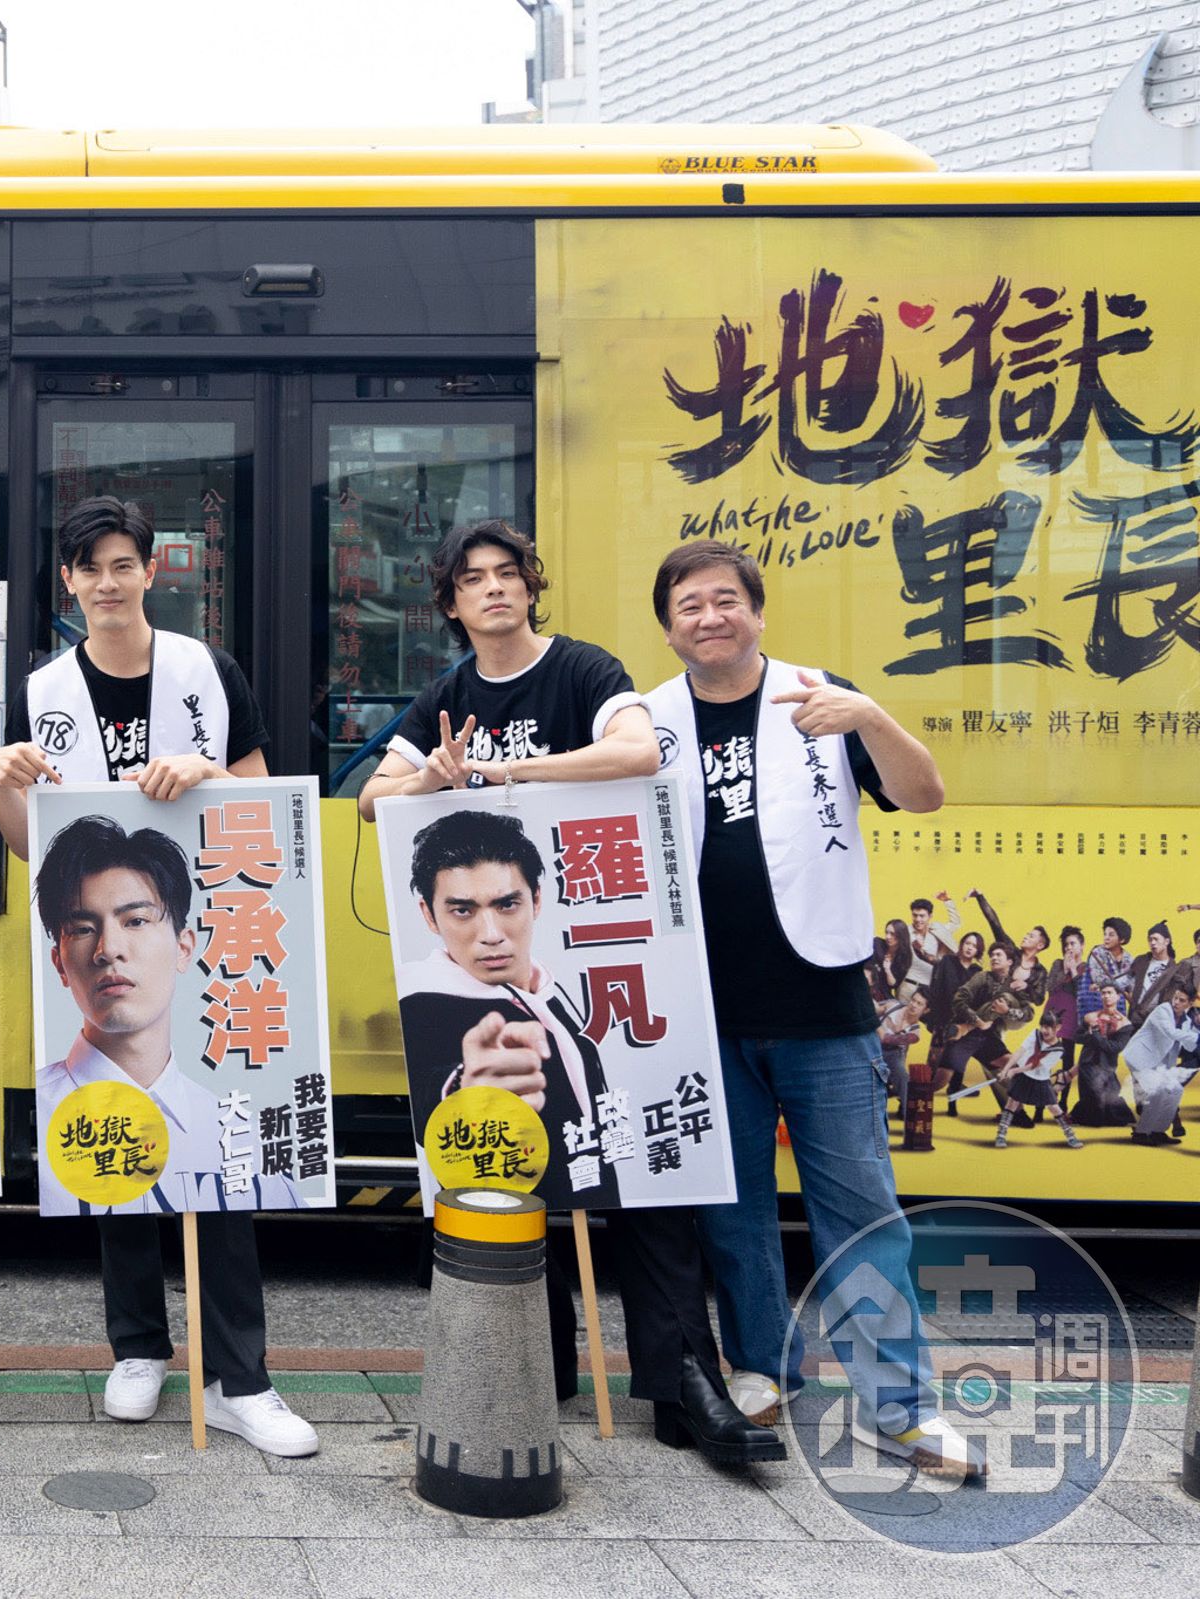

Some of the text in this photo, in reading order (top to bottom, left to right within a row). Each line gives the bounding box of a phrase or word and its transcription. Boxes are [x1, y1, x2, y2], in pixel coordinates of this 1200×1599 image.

[685, 156, 817, 168] BLUE STAR
[658, 268, 1200, 486] 地獄
[883, 480, 1200, 686] 里長
[38, 716, 74, 752] 78
[922, 717, 952, 732] 導演
[962, 710, 1032, 733] 瞿友寧
[196, 800, 290, 1068] 吳承洋
[554, 814, 668, 1047] 羅一凡
[60, 1115, 140, 1148] 地獄
[218, 1088, 253, 1196] 大仁哥
[259, 1103, 293, 1177] 新版
[293, 1072, 327, 1179] 我要當
[437, 1118, 517, 1151] 地獄
[642, 1099, 682, 1175] 正義
[675, 1071, 713, 1145] 公平
[94, 1145, 158, 1177] 里長
[473, 1149, 538, 1179] 里長
[563, 1115, 602, 1193] 社會
